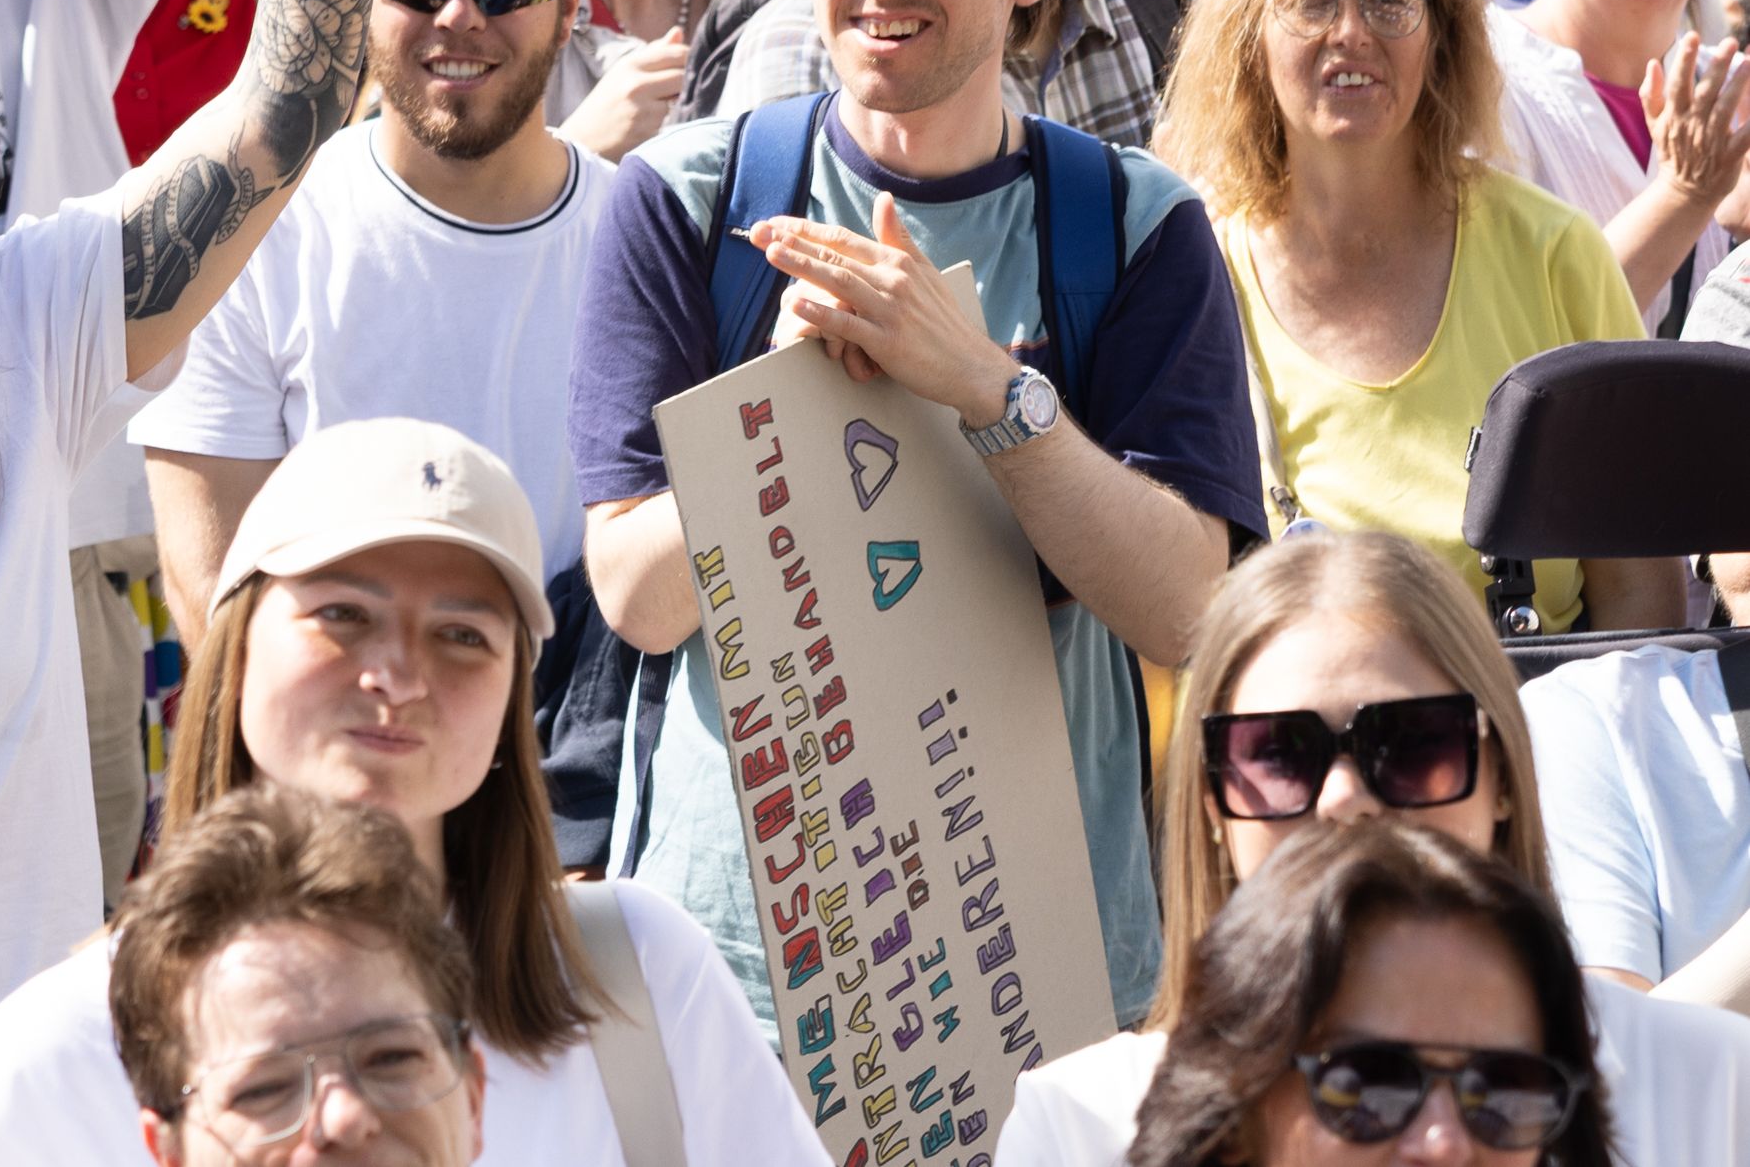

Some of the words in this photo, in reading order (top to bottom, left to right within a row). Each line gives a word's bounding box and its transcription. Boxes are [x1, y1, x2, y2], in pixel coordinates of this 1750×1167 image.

[694, 544, 750, 682] MIT
[739, 397, 856, 766] BEHANDELT
[729, 693, 847, 1130] MENSCHEN
[839, 777, 924, 1052] GLEICH
[890, 819, 931, 911] DIE
[918, 936, 962, 1044] WIE
